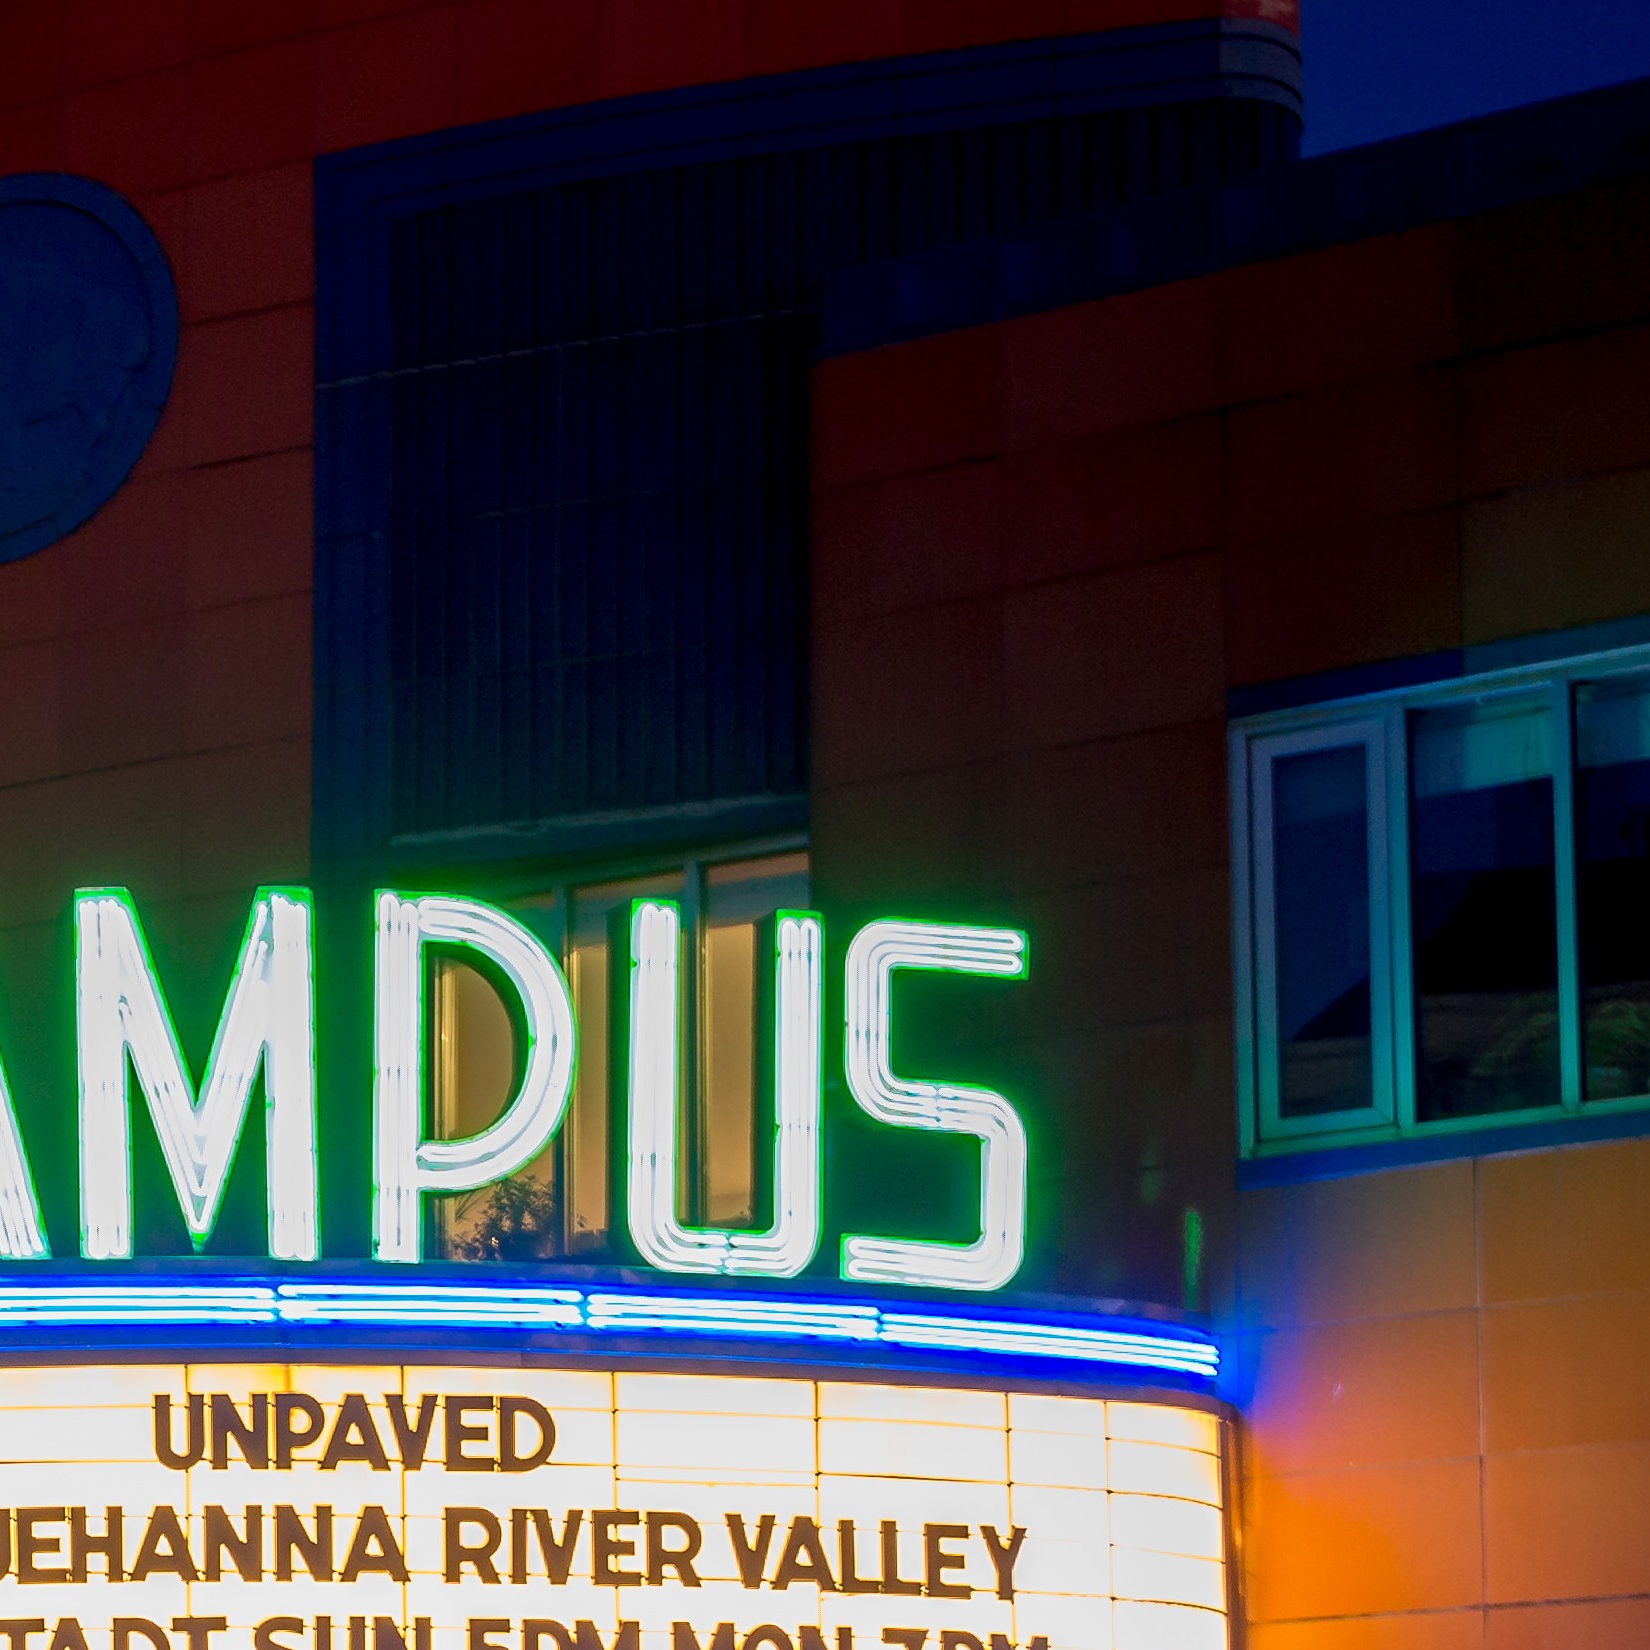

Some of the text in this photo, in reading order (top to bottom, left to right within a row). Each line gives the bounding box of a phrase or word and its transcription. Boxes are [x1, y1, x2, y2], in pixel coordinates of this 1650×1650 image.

[154, 1392, 556, 1472] UNPAVED
[444, 1506, 702, 1588] RIVER
[724, 1512, 1028, 1601] VALLEY
